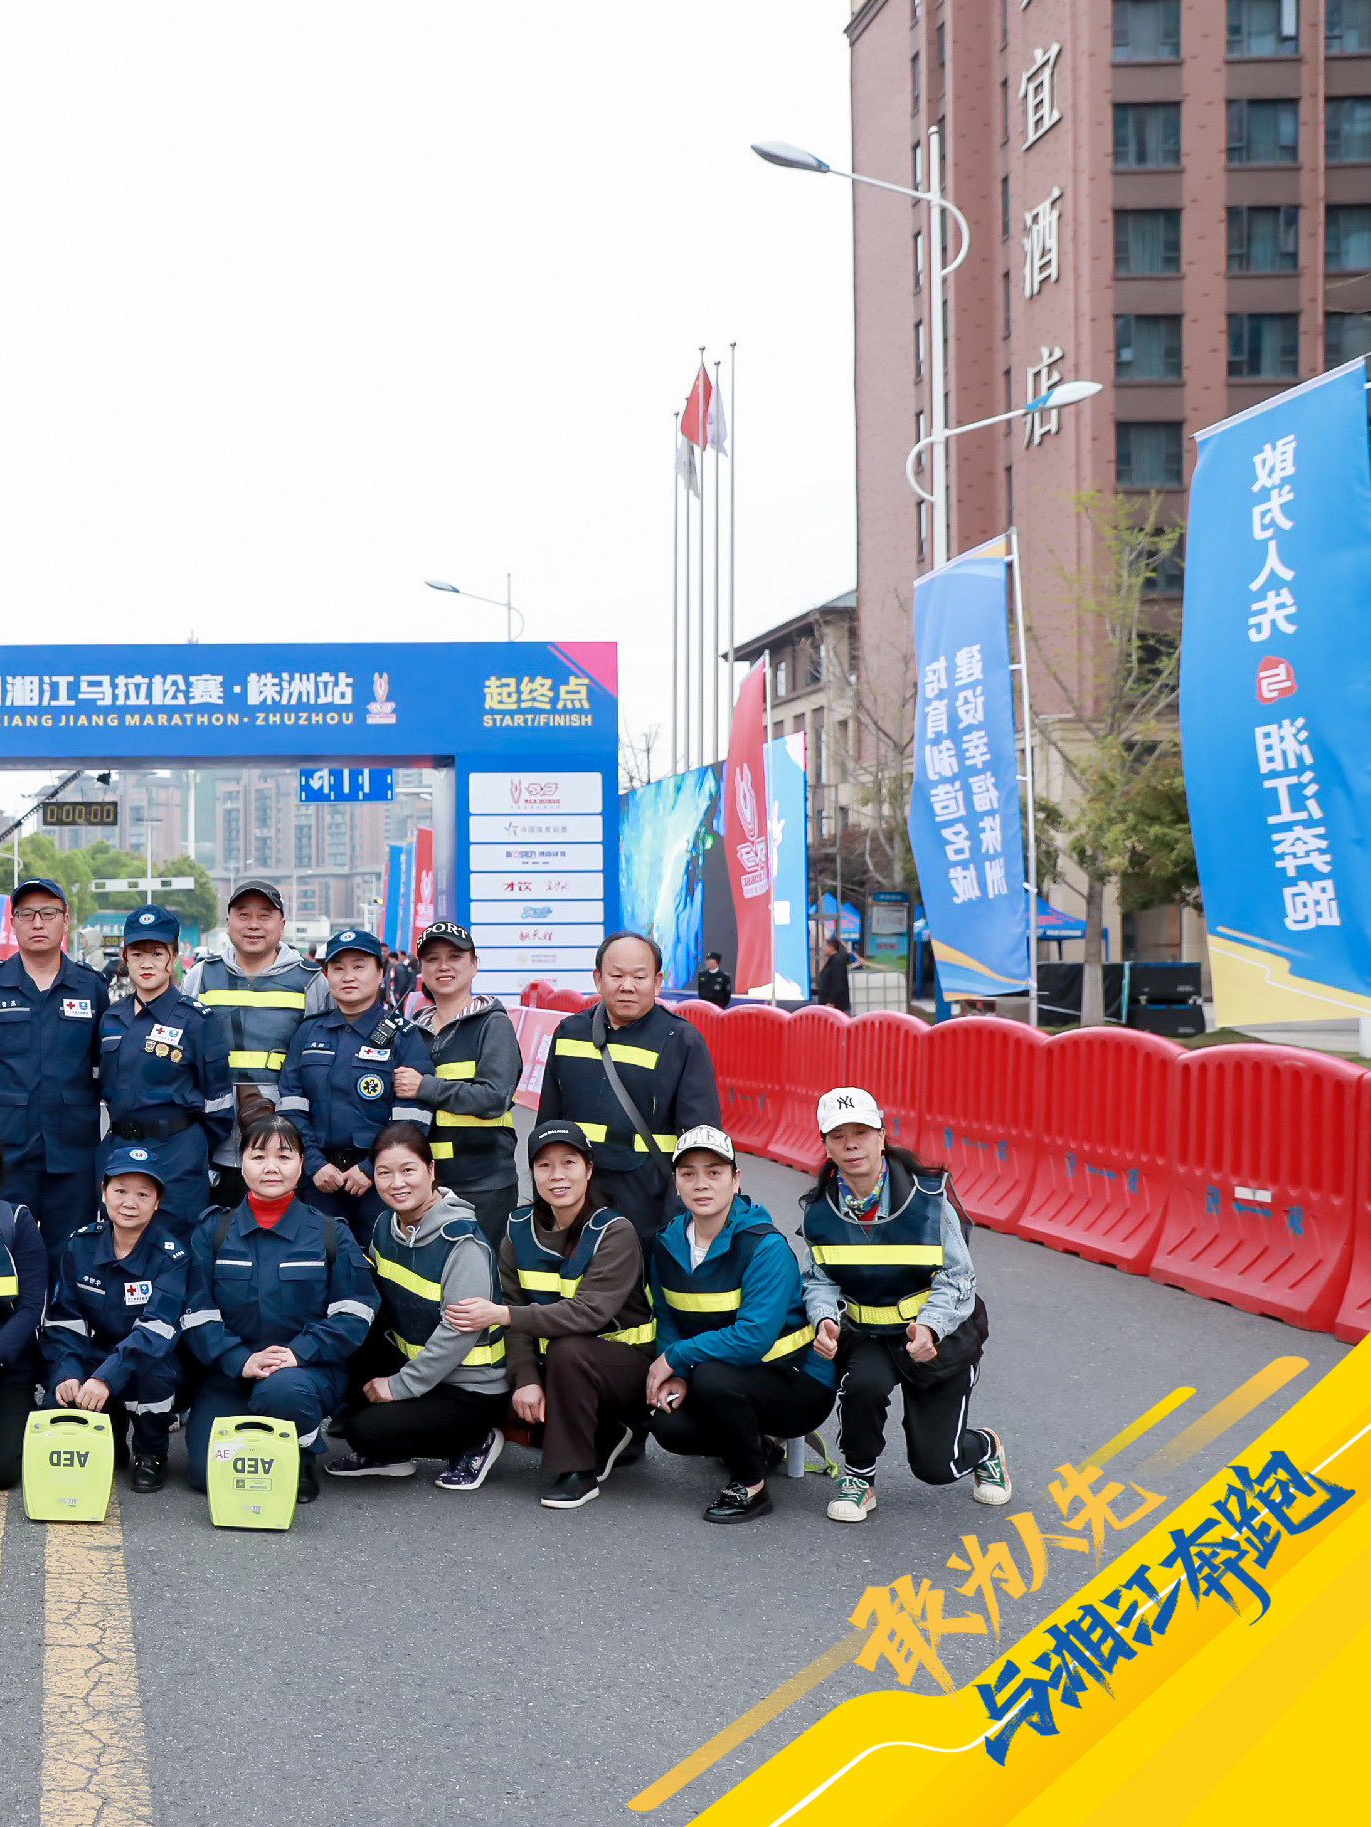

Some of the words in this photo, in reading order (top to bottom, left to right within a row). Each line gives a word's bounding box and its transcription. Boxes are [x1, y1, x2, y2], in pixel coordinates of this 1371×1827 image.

[1018, 0, 1064, 450] 宜酒店
[483, 674, 591, 709] 起终点
[58, 714, 119, 727] JIANG
[255, 713, 355, 725] ZHUZHOU
[483, 714, 593, 727] START/FINISH
[48, 1450, 90, 1468] AED
[232, 1457, 275, 1475] AED
